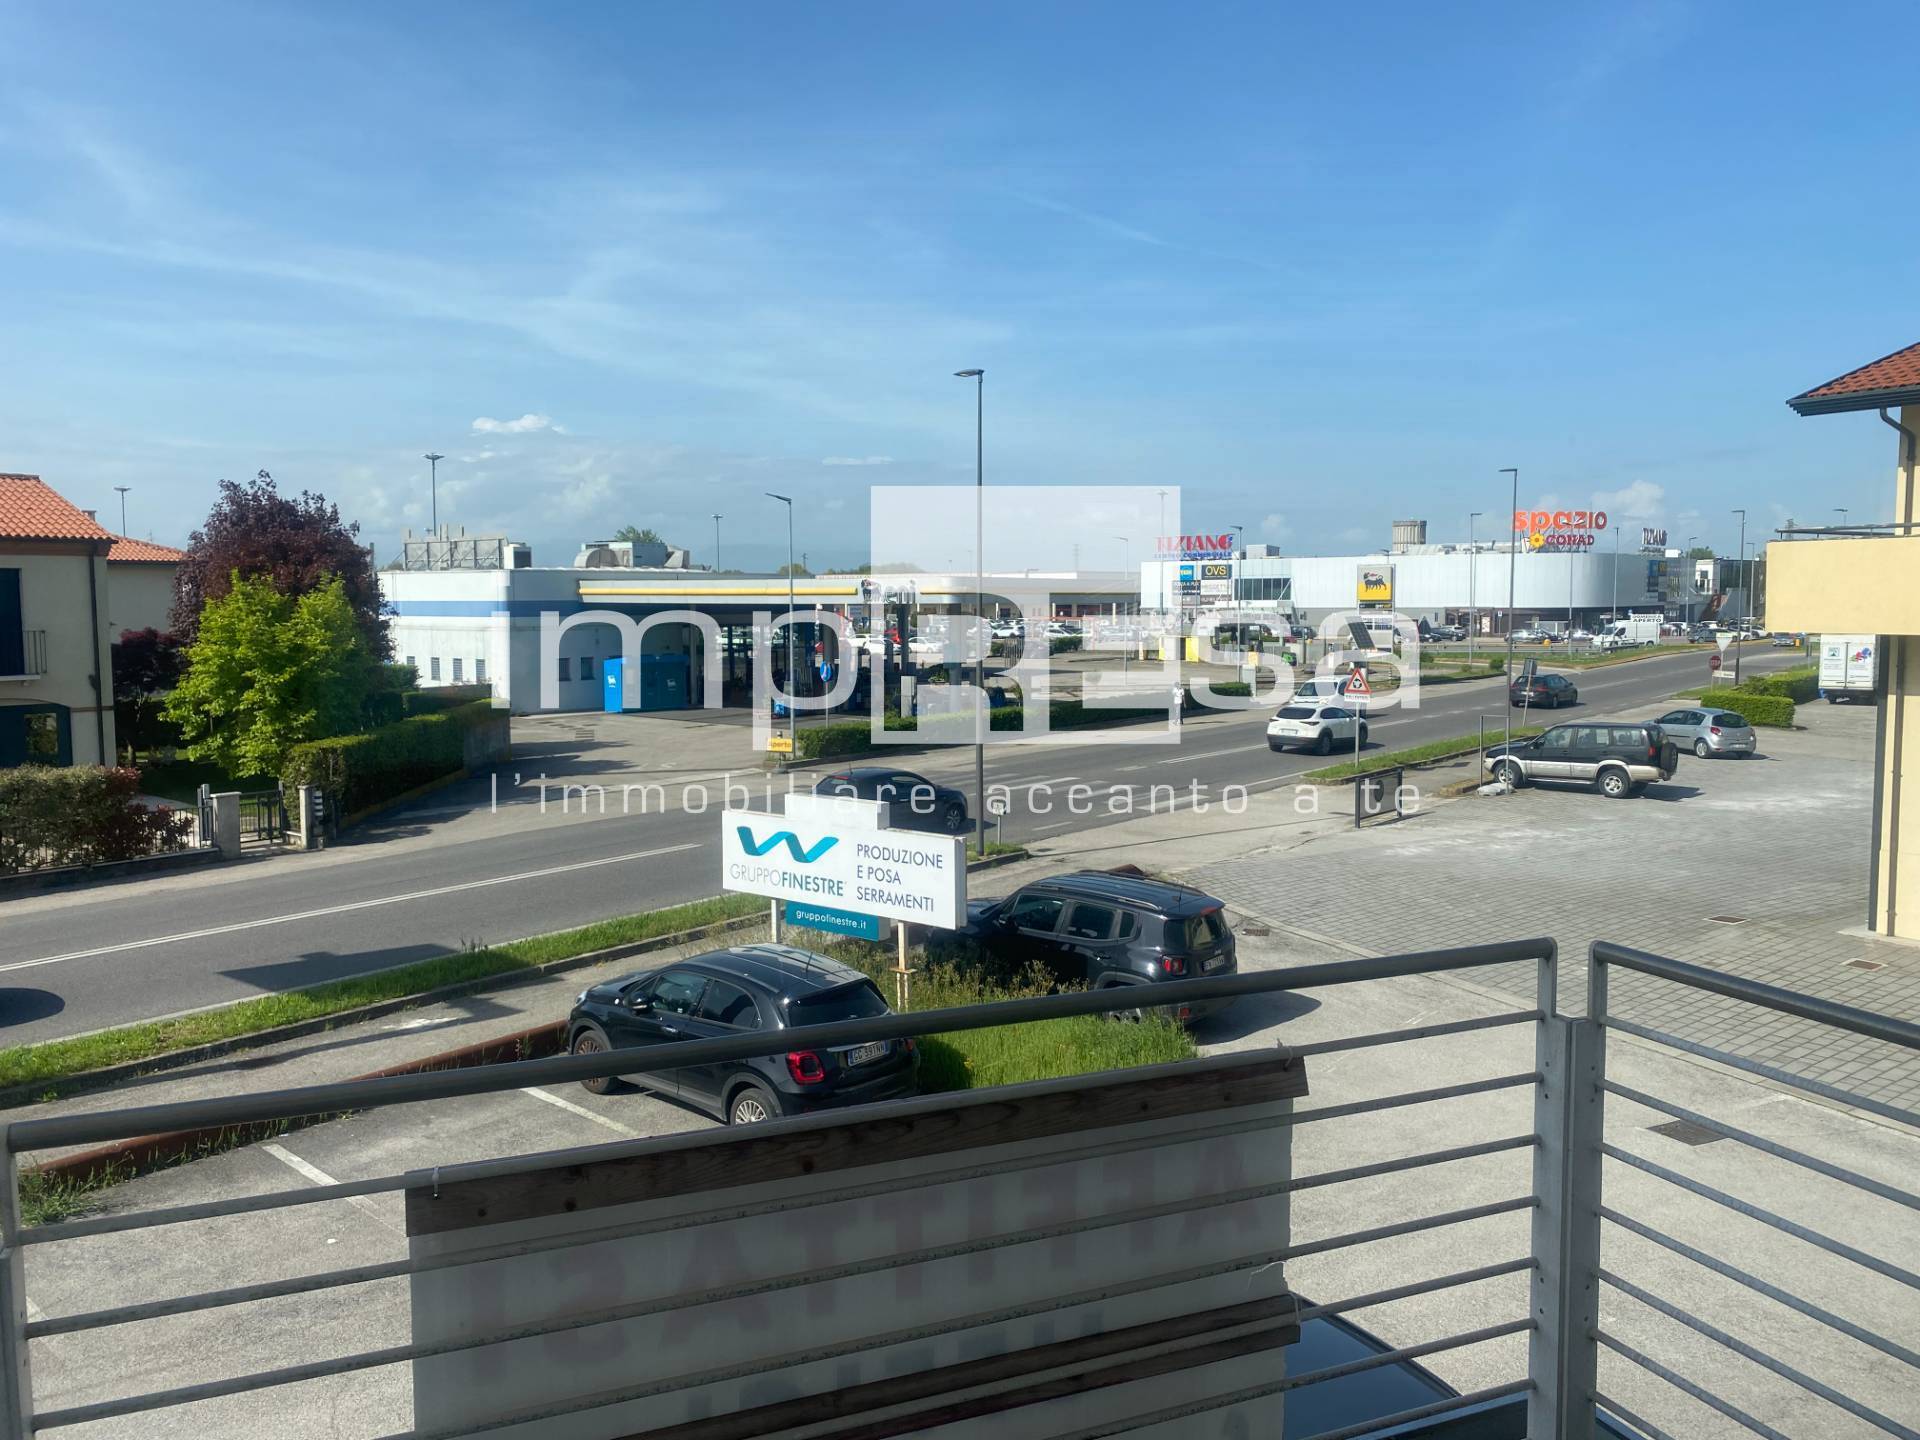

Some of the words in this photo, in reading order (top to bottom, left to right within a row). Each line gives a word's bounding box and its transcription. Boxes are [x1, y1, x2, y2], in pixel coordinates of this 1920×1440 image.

[1512, 511, 1607, 532] spazio
[1545, 534, 1595, 546] CONAD
[1205, 565, 1226, 576] OVS
[857, 843, 943, 869] PRODUZIONE
[730, 863, 844, 897] GRUPPOFINESTRE
[857, 865, 863, 879] E
[867, 866, 902, 885] POSA
[856, 886, 934, 912] SERRAMENTI
[795, 908, 867, 930] gruppofinestre.it
